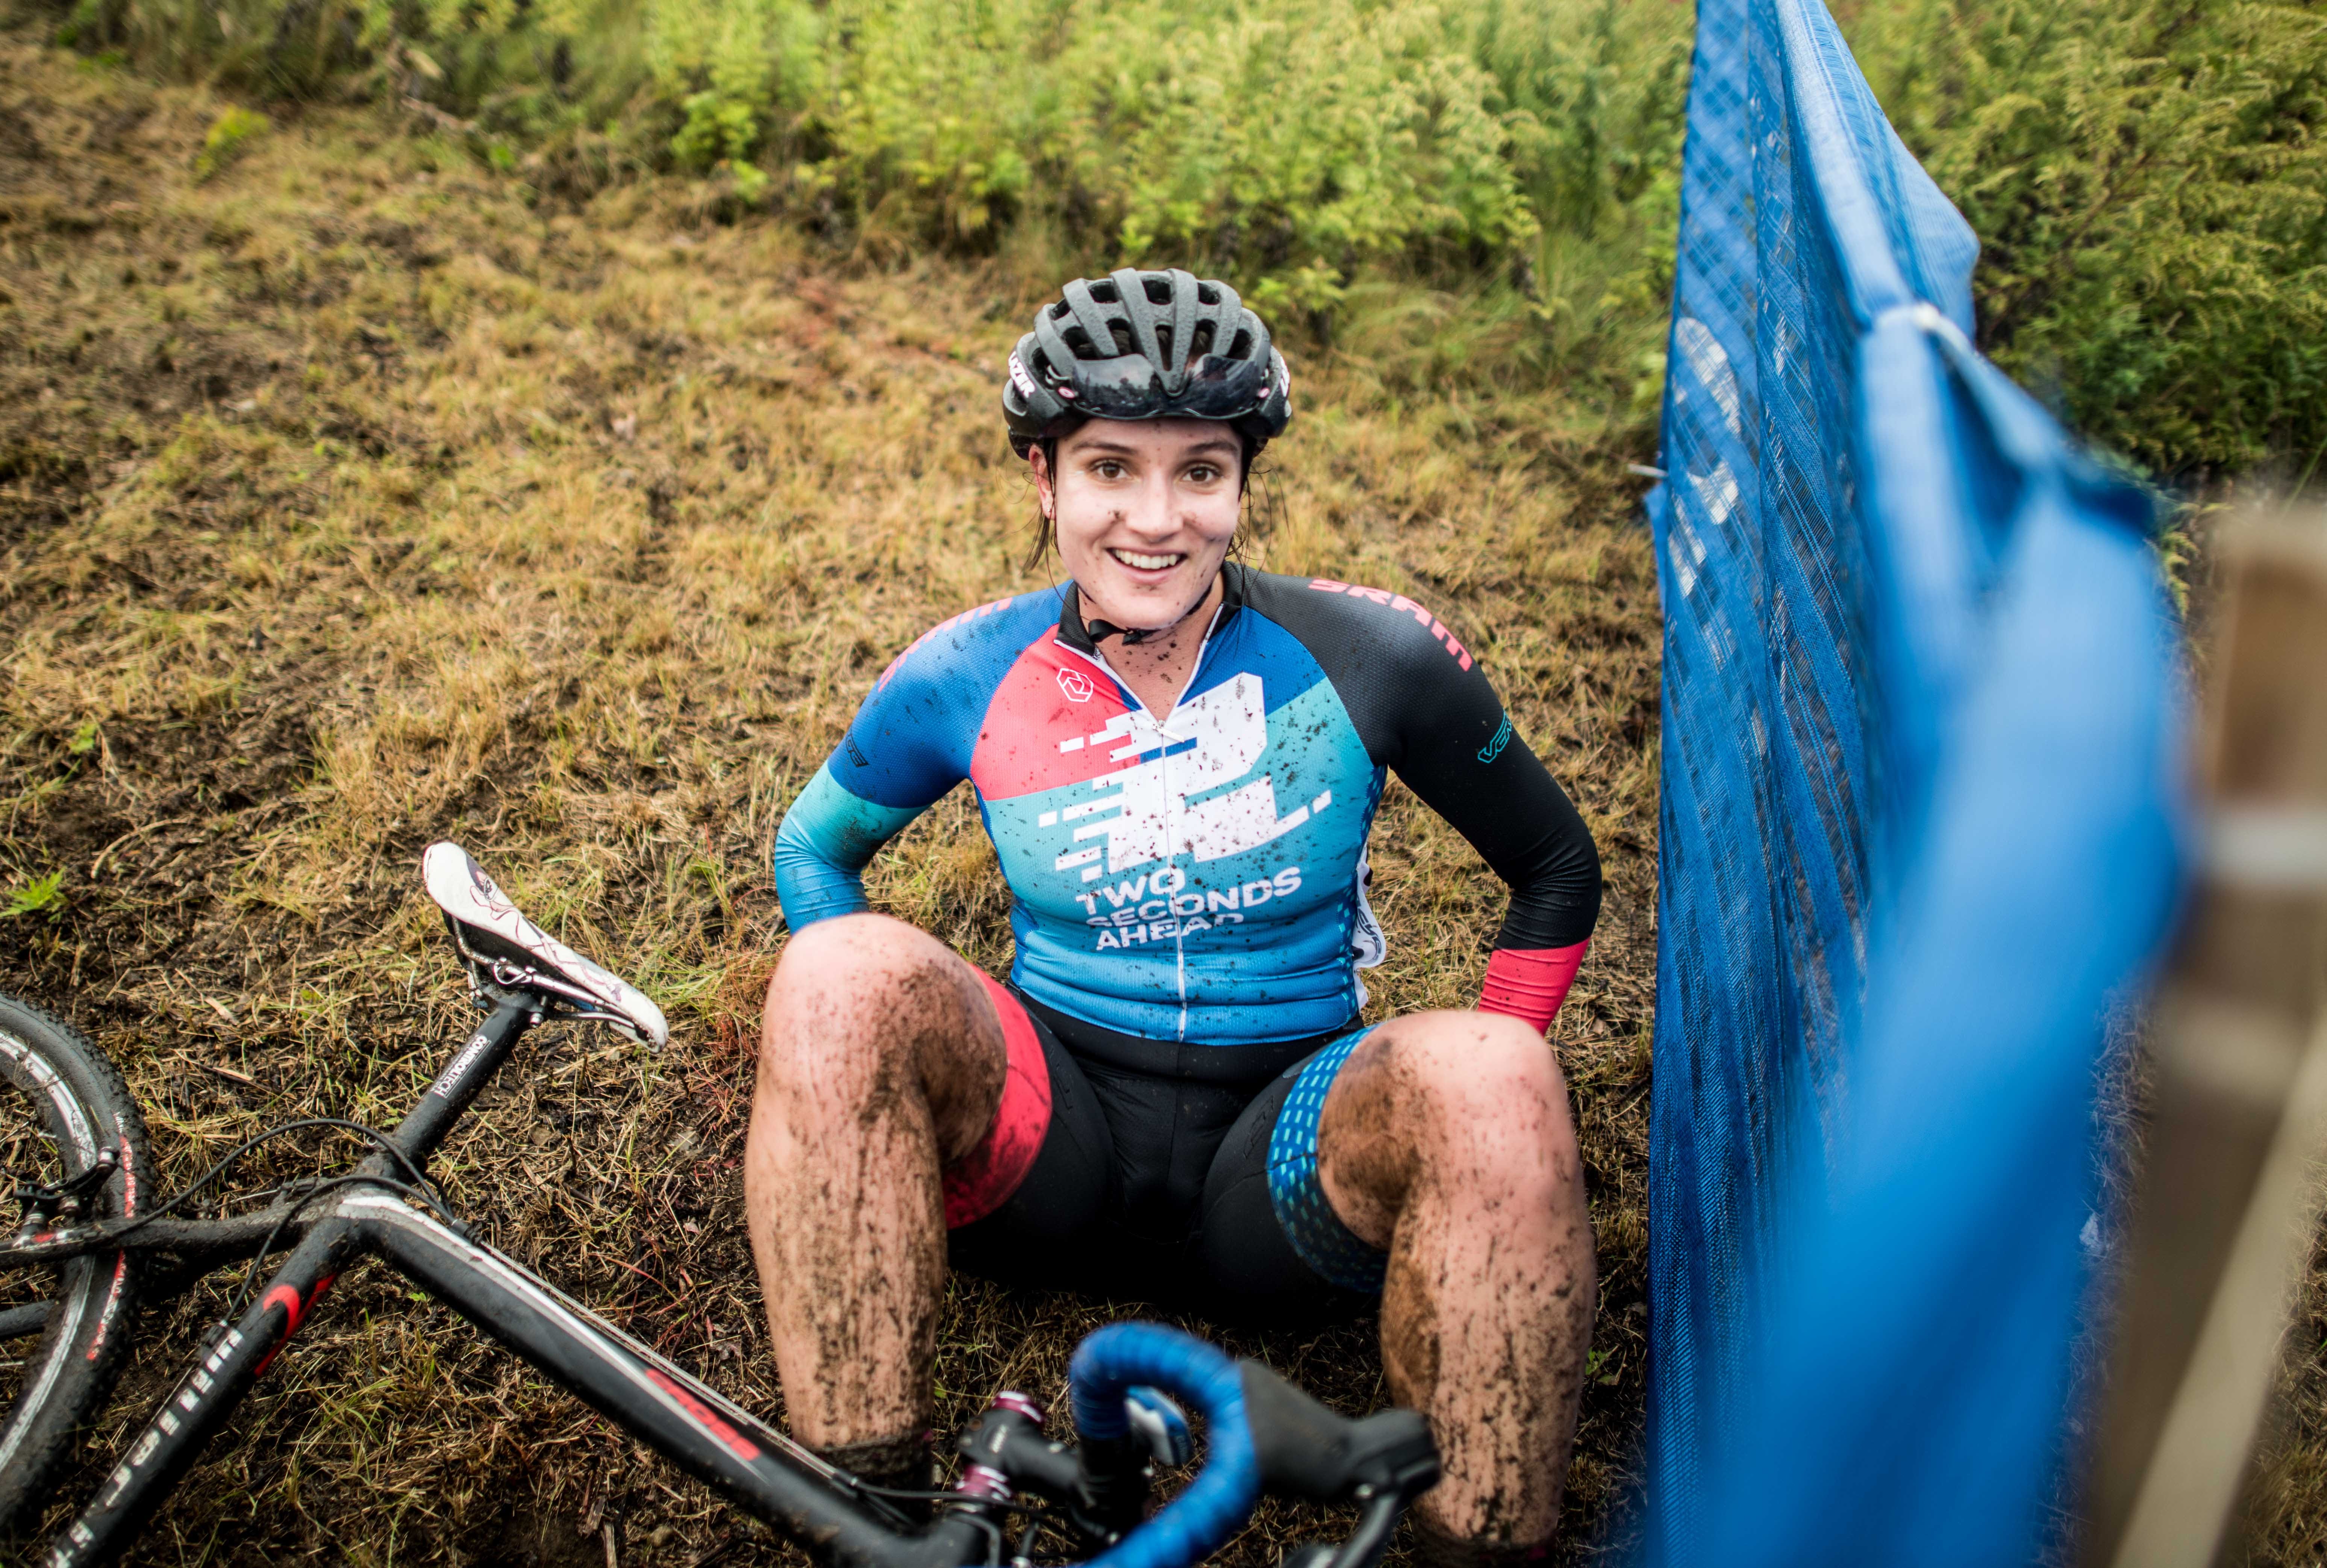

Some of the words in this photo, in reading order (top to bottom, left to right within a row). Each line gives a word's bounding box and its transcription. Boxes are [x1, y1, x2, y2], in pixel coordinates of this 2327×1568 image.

[1308, 578, 1473, 672] SRAM
[1076, 867, 1186, 915] TWO
[1086, 867, 1302, 927] SECONDS
[1096, 913, 1244, 951] AHEAD
[433, 1035, 488, 1098] CONTROLTECH
